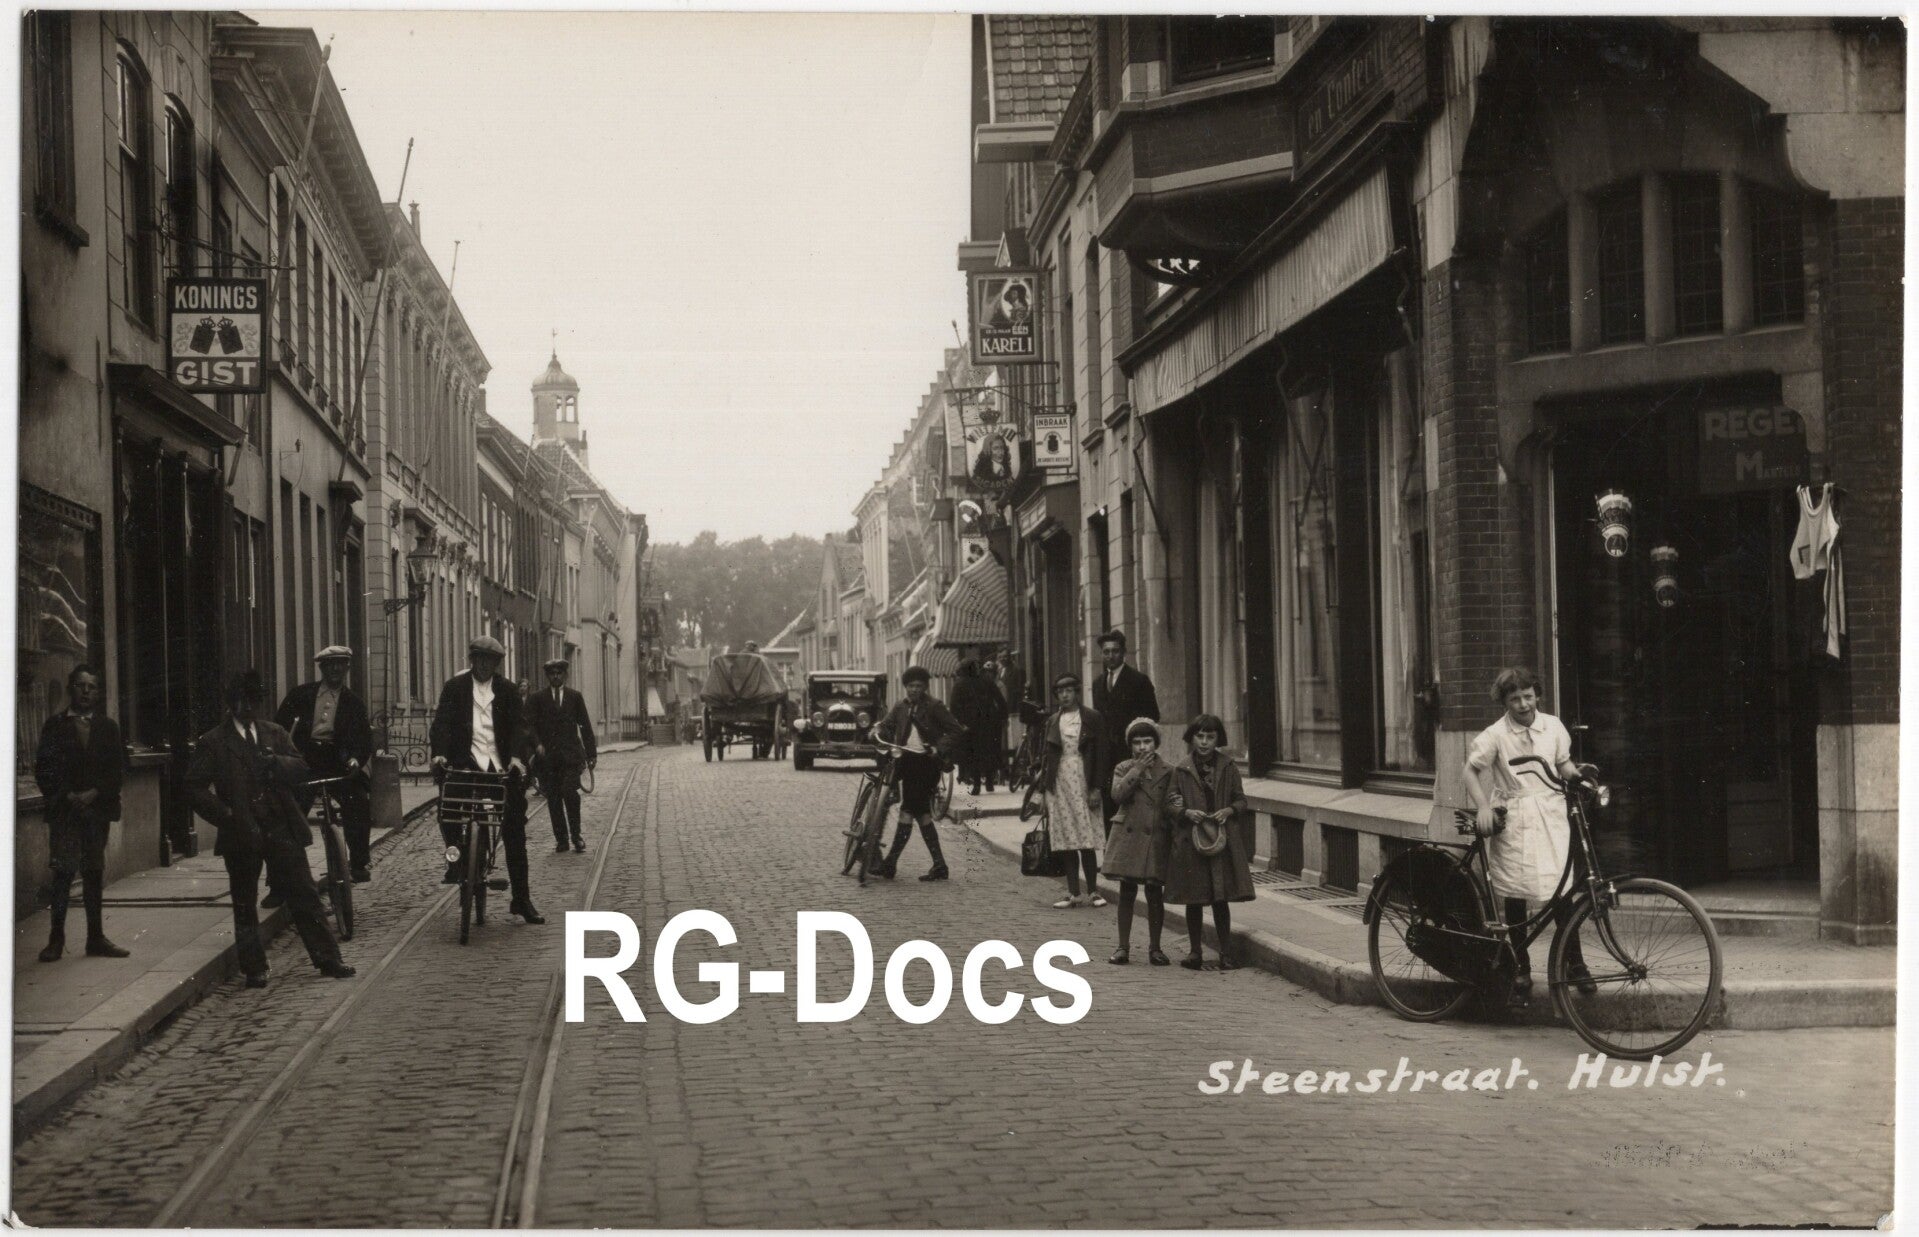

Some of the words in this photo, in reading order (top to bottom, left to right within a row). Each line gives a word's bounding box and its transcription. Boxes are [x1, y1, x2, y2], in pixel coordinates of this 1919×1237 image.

[175, 285, 258, 309] KONINGS
[982, 337, 1026, 353] KAREL
[176, 361, 257, 385] GIST
[1035, 418, 1068, 426] INBRAAK
